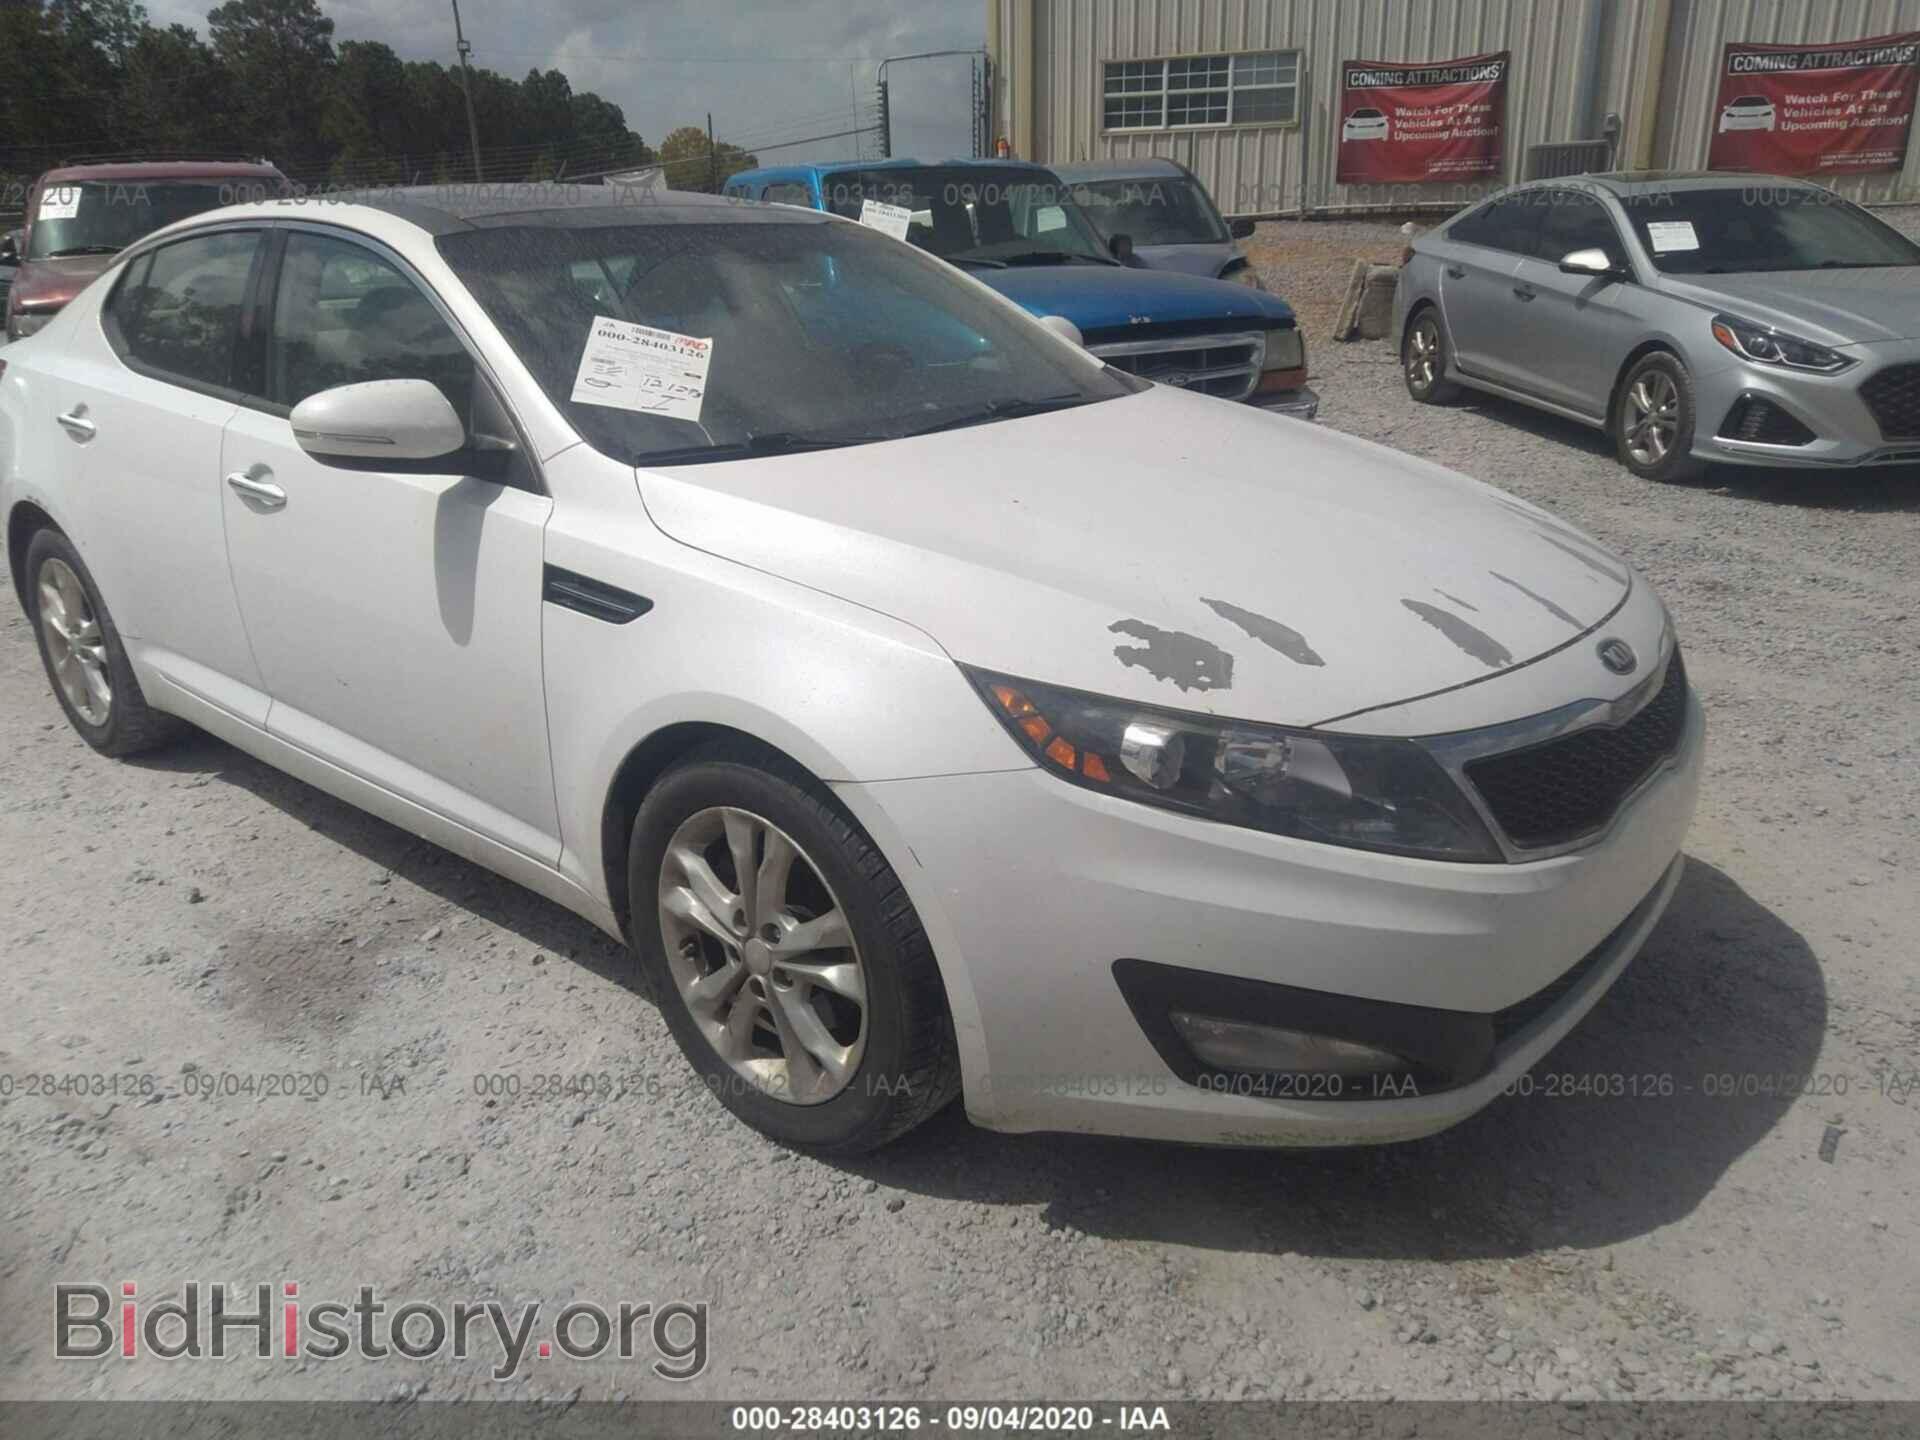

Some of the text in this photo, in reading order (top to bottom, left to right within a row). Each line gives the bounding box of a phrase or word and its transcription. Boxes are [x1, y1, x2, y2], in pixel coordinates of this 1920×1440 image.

[1734, 46, 1915, 71] COMING ATTRACTIONS
[1351, 64, 1500, 86] COMING ATTRACTIONS
[1785, 89, 1901, 104] Watch For These
[1395, 107, 1432, 117] Watch
[1457, 103, 1492, 114] These
[1784, 103, 1888, 117] Vehicles At An
[1395, 119, 1444, 129] Vehicles
[1781, 113, 1909, 132] Upcoming Auction!
[1394, 126, 1499, 142] Upcoming Auction!
[597, 329, 705, 360] 000-28403126
